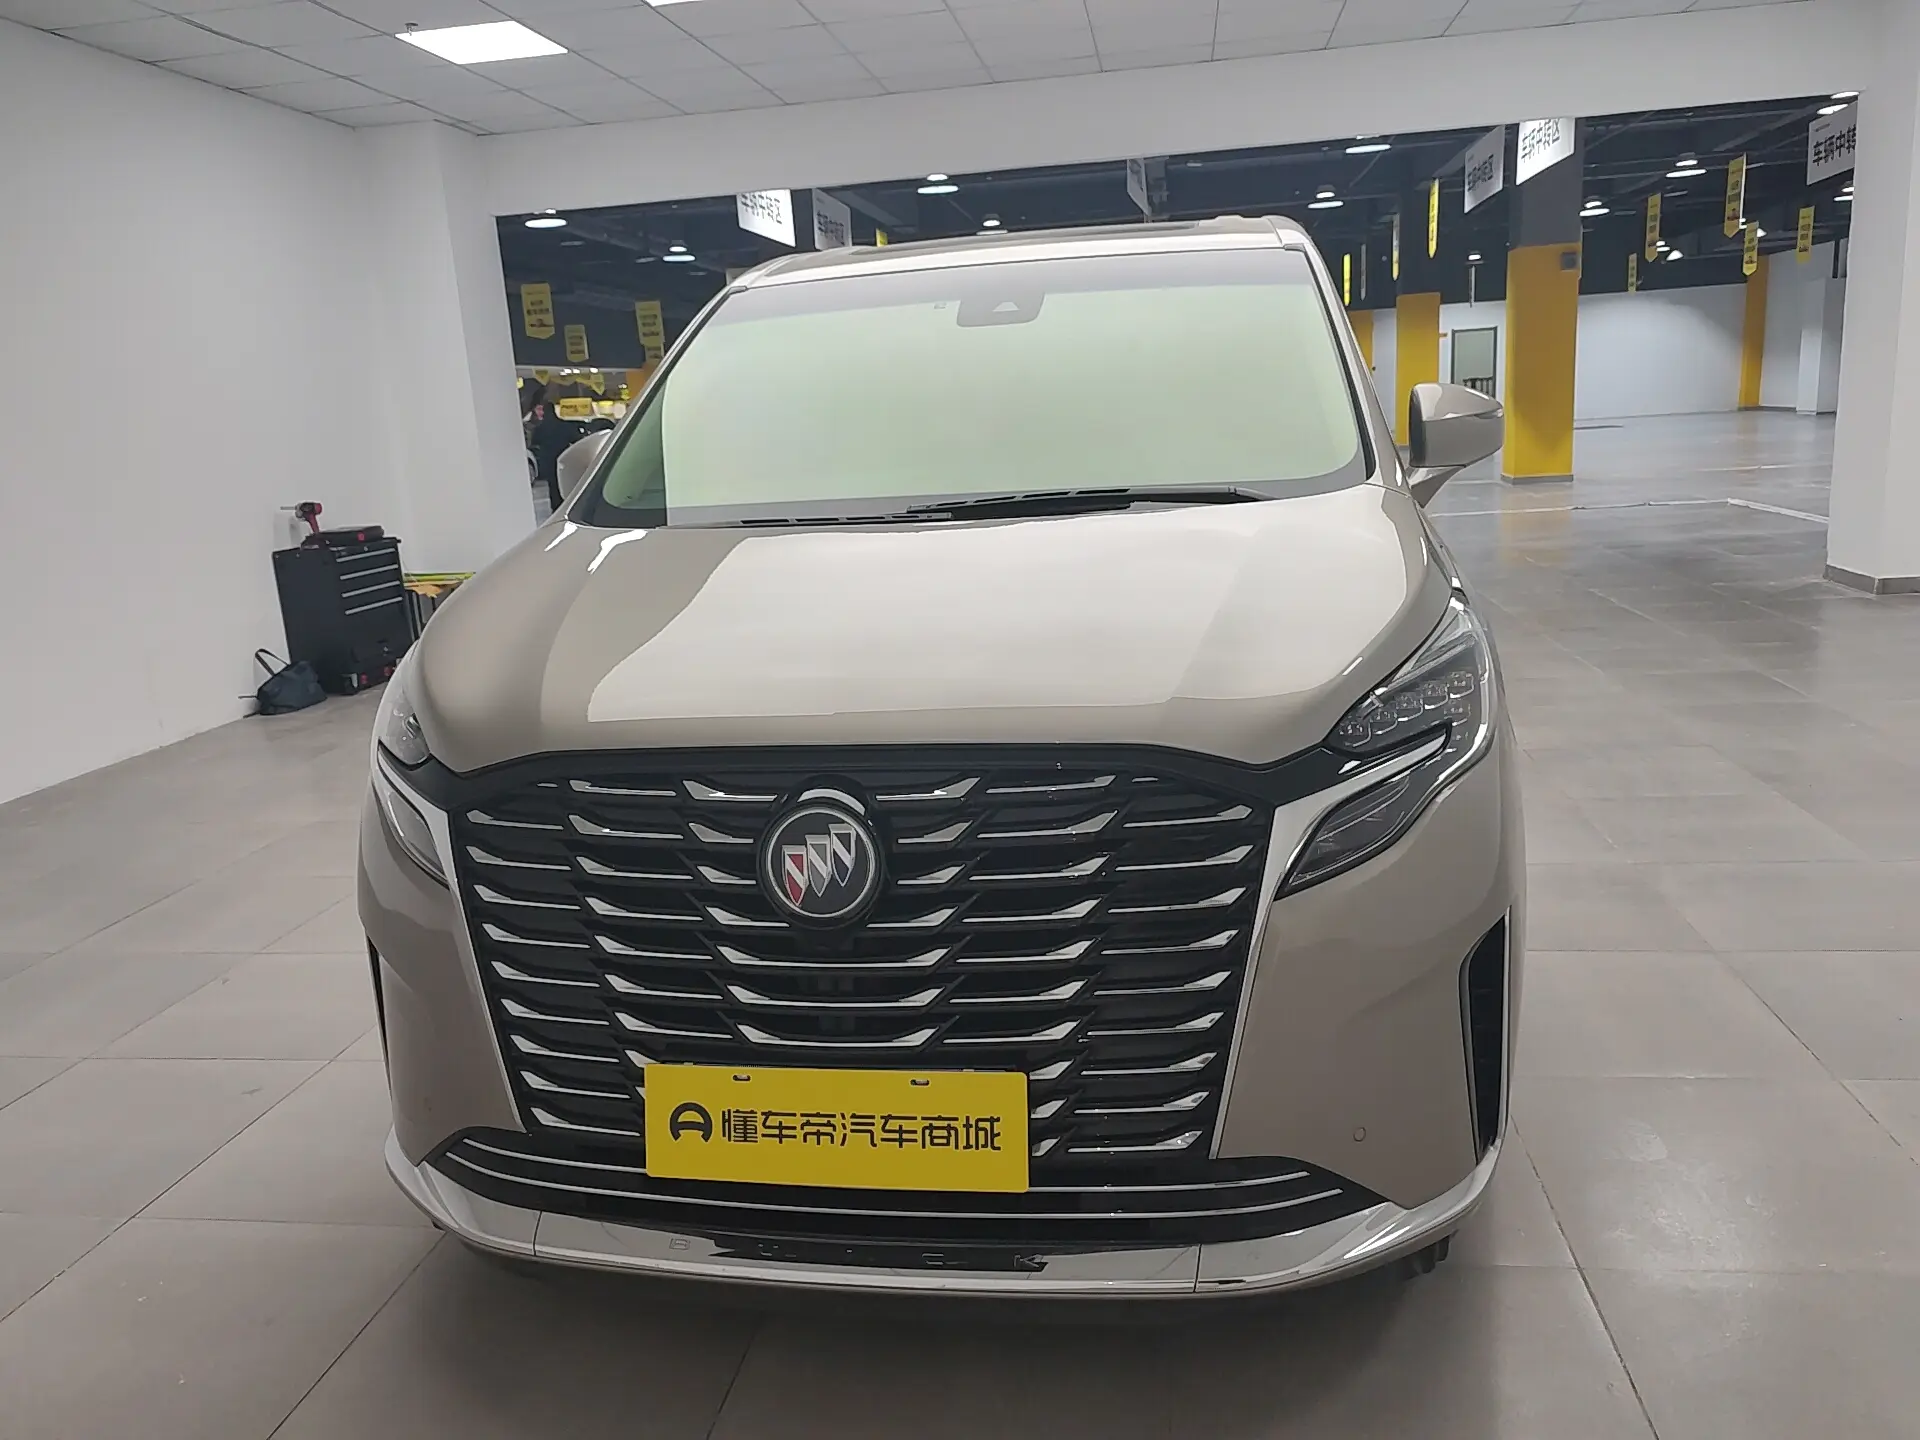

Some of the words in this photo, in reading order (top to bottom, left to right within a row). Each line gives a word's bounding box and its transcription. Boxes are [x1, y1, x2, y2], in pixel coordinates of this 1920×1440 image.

[721, 1107, 1002, 1152] 懂车帝汽车商城
[669, 1237, 1044, 1269] BCK
